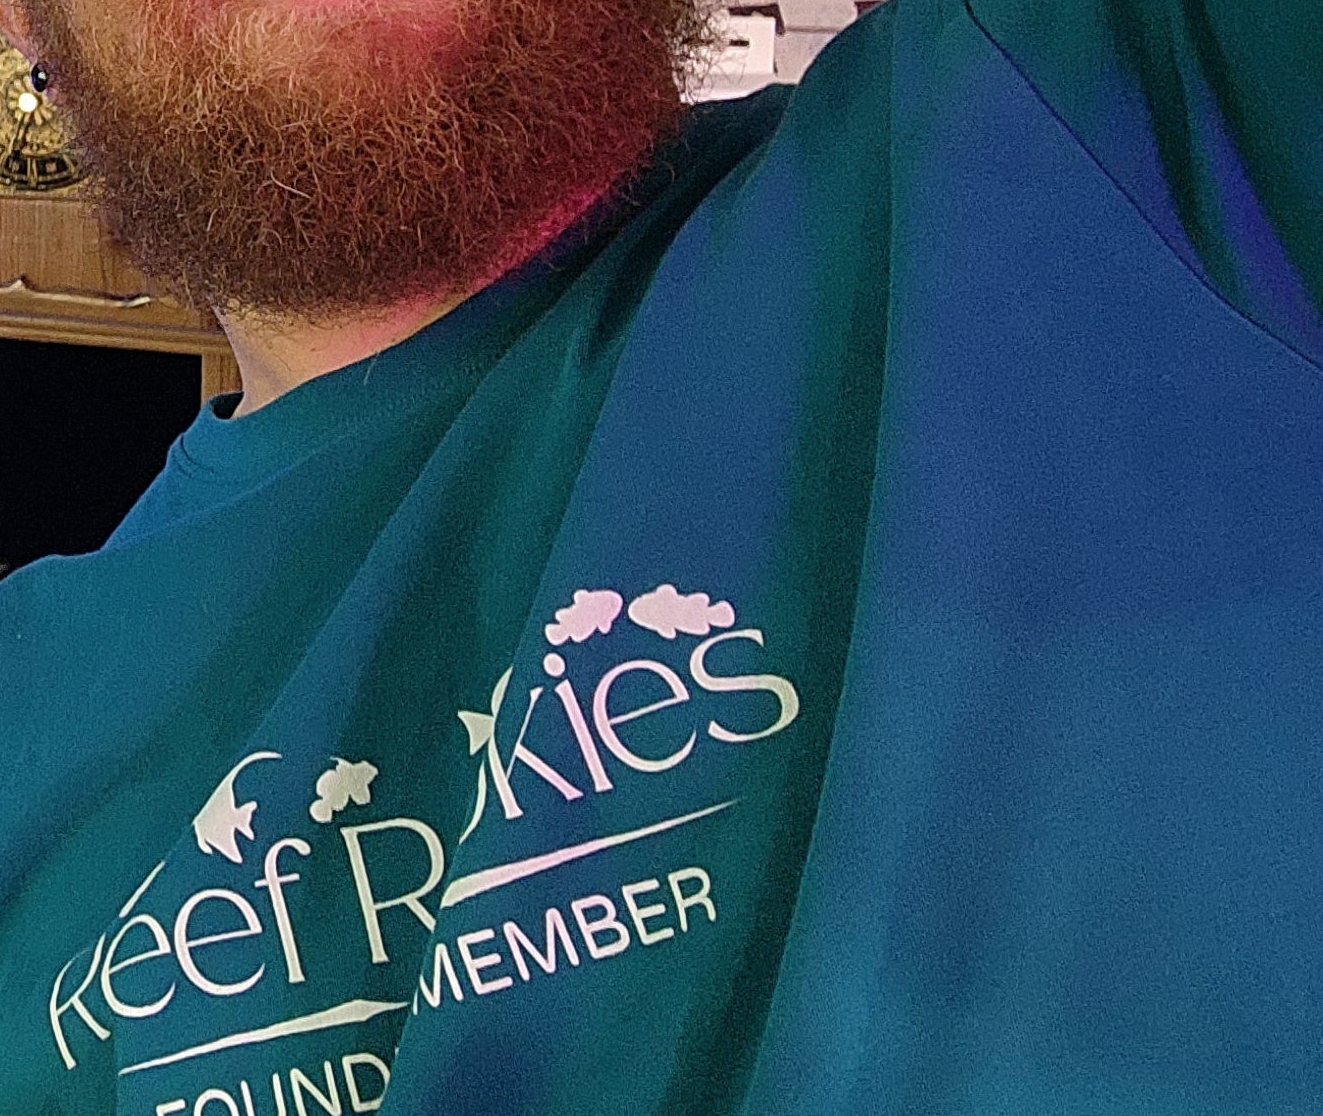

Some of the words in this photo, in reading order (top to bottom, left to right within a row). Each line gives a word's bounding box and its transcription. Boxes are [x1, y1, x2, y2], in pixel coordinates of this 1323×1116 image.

[50, 839, 311, 1070] Reef
[155, 1053, 391, 1116] UND
[412, 867, 717, 1015] MEMBER
